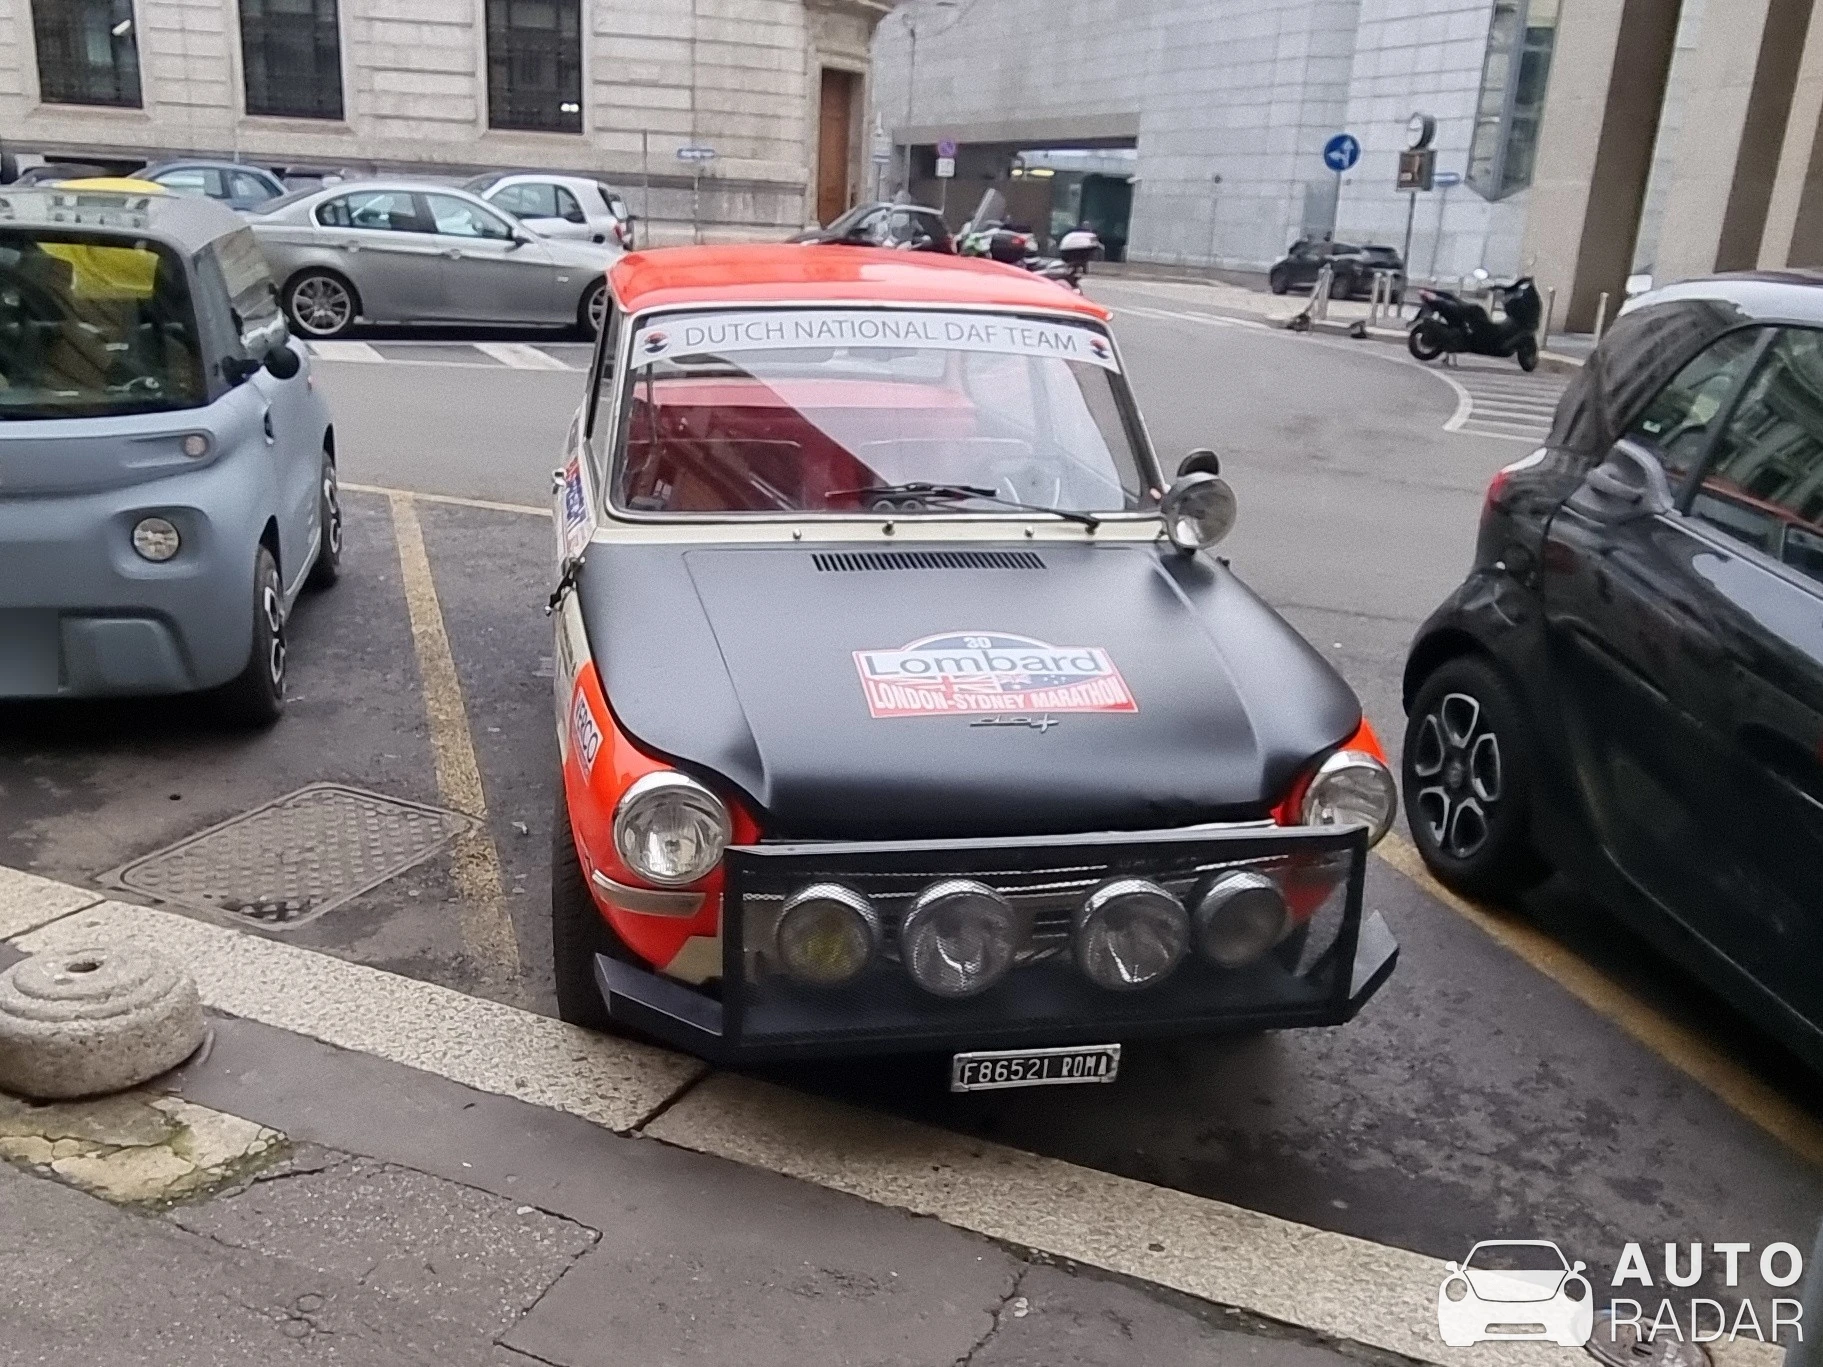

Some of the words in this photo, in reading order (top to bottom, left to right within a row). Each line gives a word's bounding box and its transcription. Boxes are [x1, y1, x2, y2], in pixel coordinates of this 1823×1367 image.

[685, 321, 785, 346] DUTCH
[795, 319, 937, 341] NATIONAL
[944, 321, 997, 343] DAF
[1003, 326, 1078, 351] TEAM
[963, 637, 992, 649] 30
[865, 649, 1104, 676] Lombard
[868, 680, 1025, 710] LONDON-SYDNEY
[1031, 675, 1129, 708] MARATHON
[1061, 1055, 1108, 1077] ROMA
